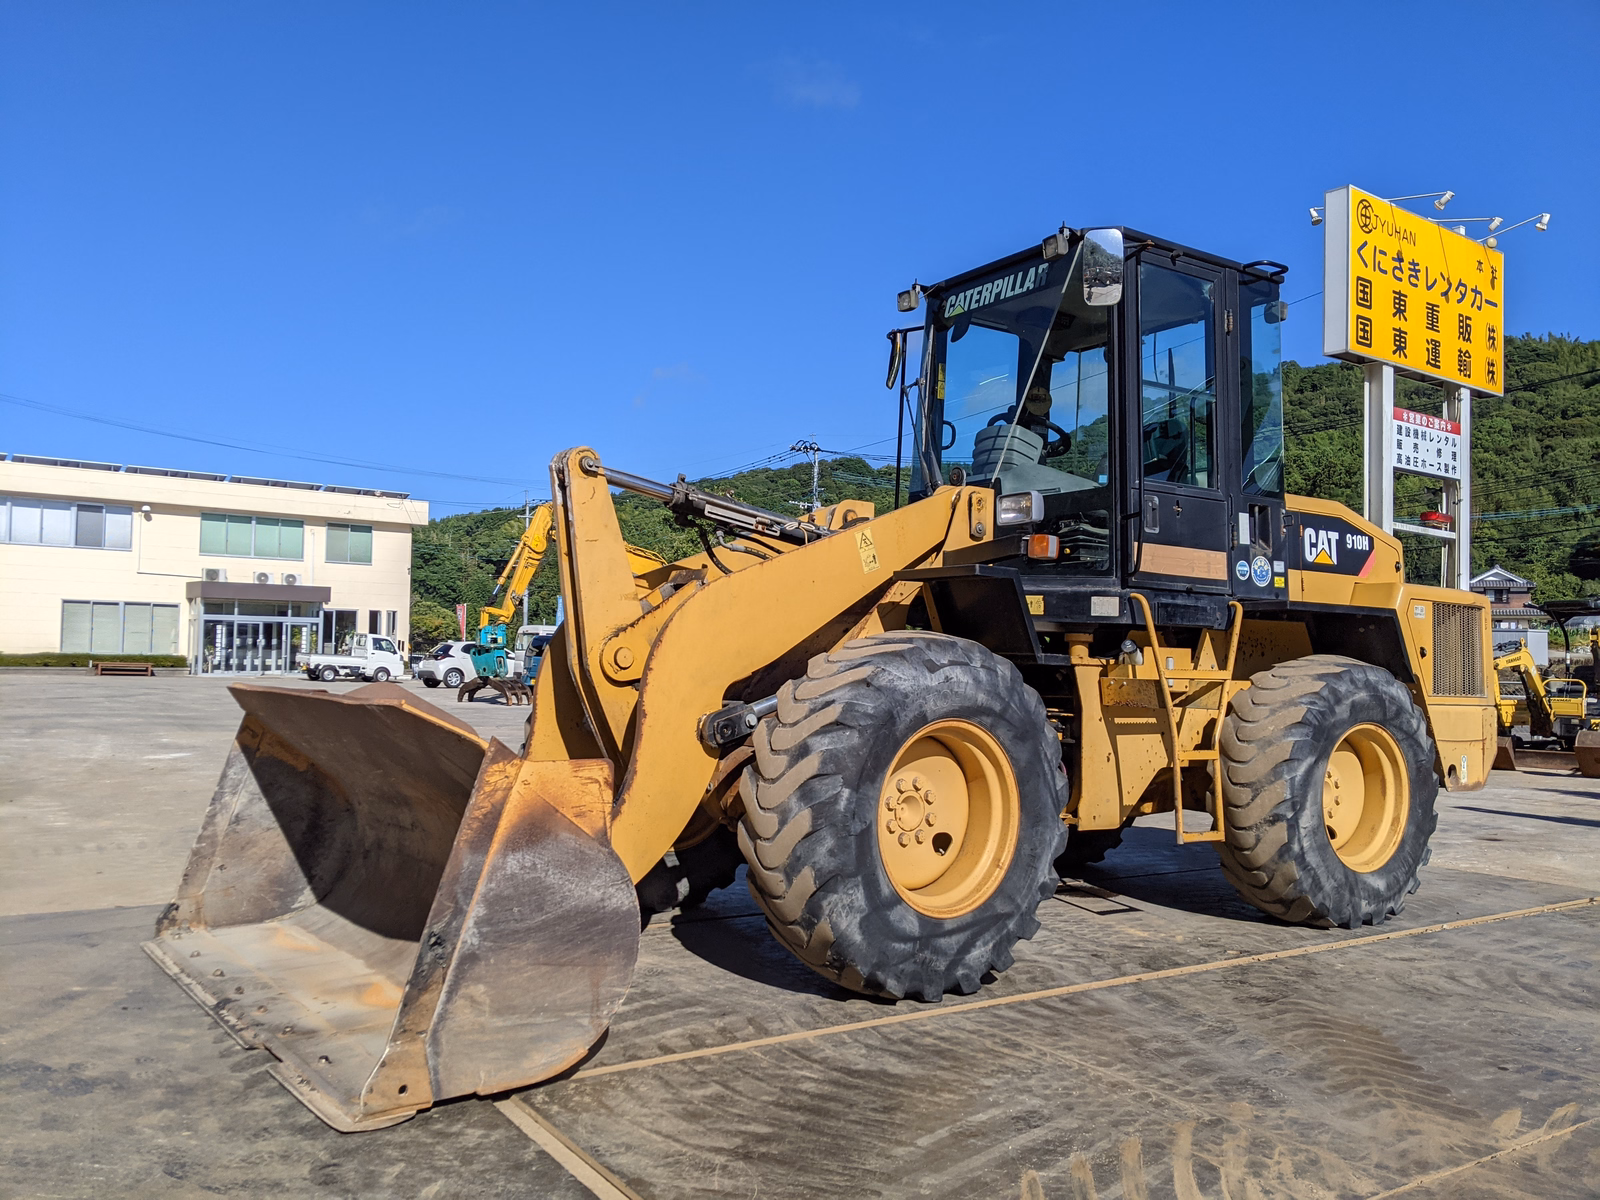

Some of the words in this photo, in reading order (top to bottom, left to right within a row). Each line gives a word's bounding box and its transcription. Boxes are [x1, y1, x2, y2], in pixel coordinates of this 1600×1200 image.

[1372, 214, 1416, 247] JYUHAN
[1357, 240, 1498, 311] くにさきレンタカー
[1476, 259, 1498, 281] 本社
[944, 262, 1050, 319] CATERPILLAR
[1396, 424, 1457, 448] 建設機械レンタル
[1304, 527, 1339, 566] CAT
[1346, 533, 1369, 551] 910H
